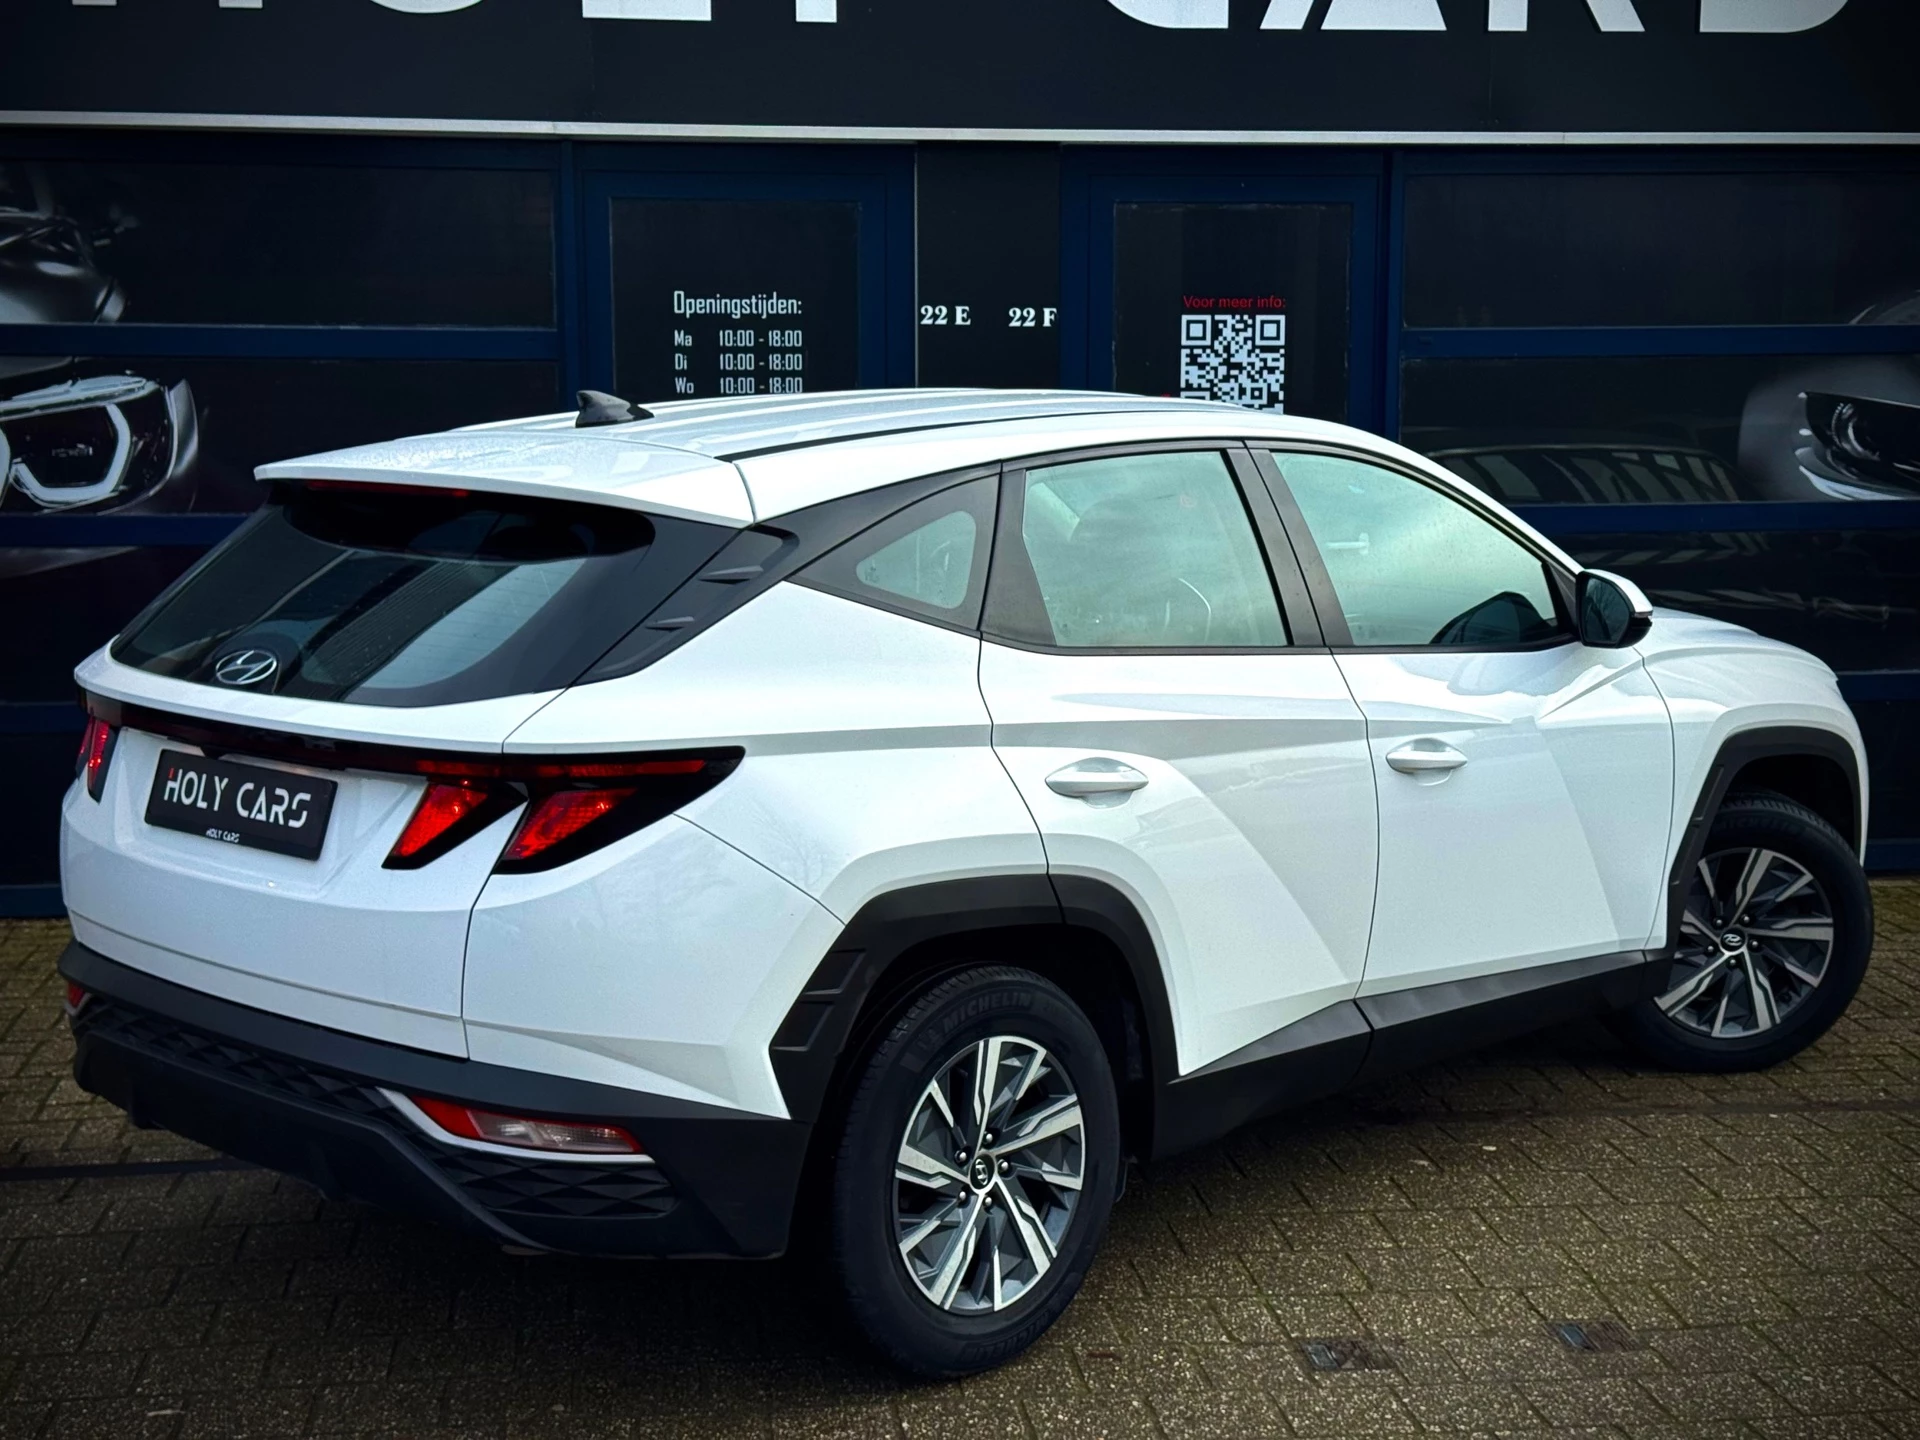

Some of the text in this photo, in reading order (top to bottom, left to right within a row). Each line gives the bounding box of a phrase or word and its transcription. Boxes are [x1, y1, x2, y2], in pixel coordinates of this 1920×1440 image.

[673, 290, 803, 319] Openingstijden:
[1183, 295, 1287, 309] Voor meer info:
[920, 305, 972, 326] 22 E
[1008, 307, 1058, 328] 22 F
[673, 329, 693, 347] Ma
[719, 329, 755, 347] 10:00
[768, 329, 802, 347] 18:00
[674, 353, 688, 371] Di
[719, 353, 755, 371] 10:00
[768, 353, 803, 371] 18:00
[674, 376, 695, 395] Wo
[719, 376, 756, 395] 10:00
[768, 376, 803, 395] 18:00
[164, 767, 312, 829] HOLY CARS
[942, 991, 1032, 1034] MICHELIN
